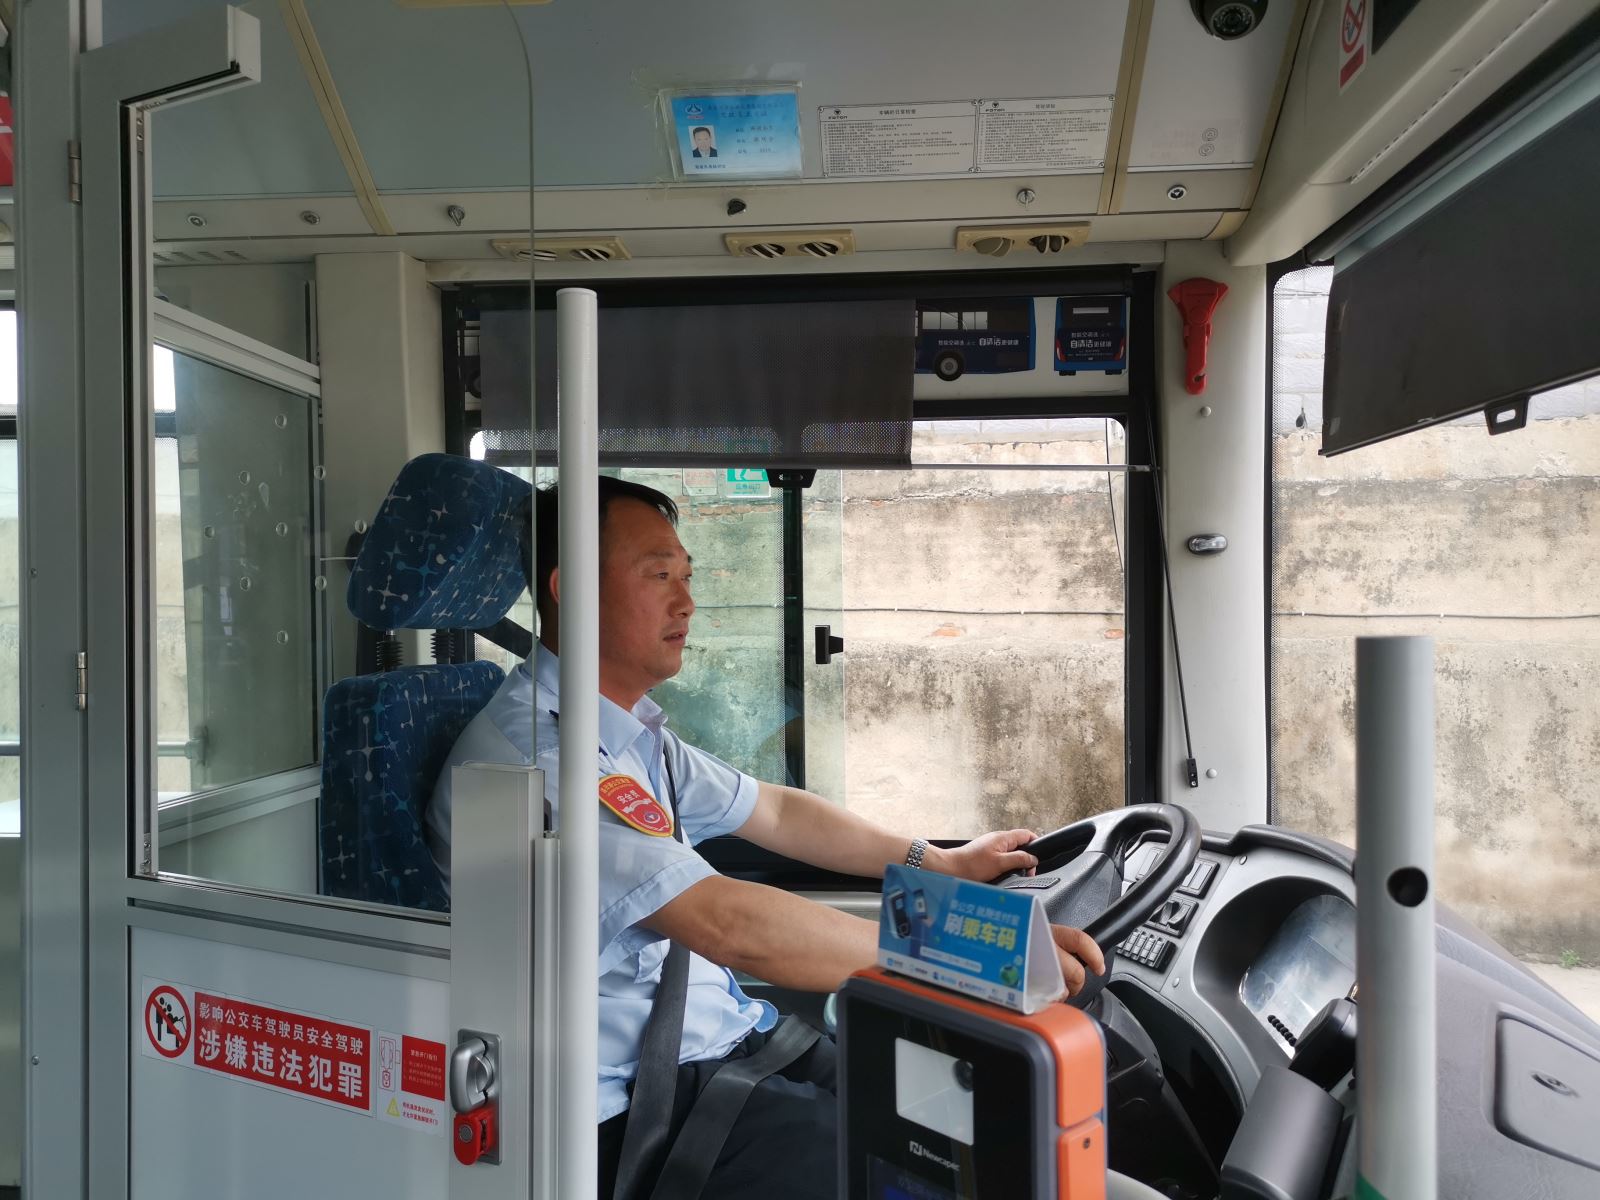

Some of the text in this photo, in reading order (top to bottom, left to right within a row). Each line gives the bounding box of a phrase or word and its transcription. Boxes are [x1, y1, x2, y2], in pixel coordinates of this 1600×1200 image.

[944, 912, 1017, 951] 刷乘车码
[199, 1002, 364, 1057] 影响公交车驾驶员安全驾驶
[198, 1027, 363, 1100] 涉嫌违法犯罪
